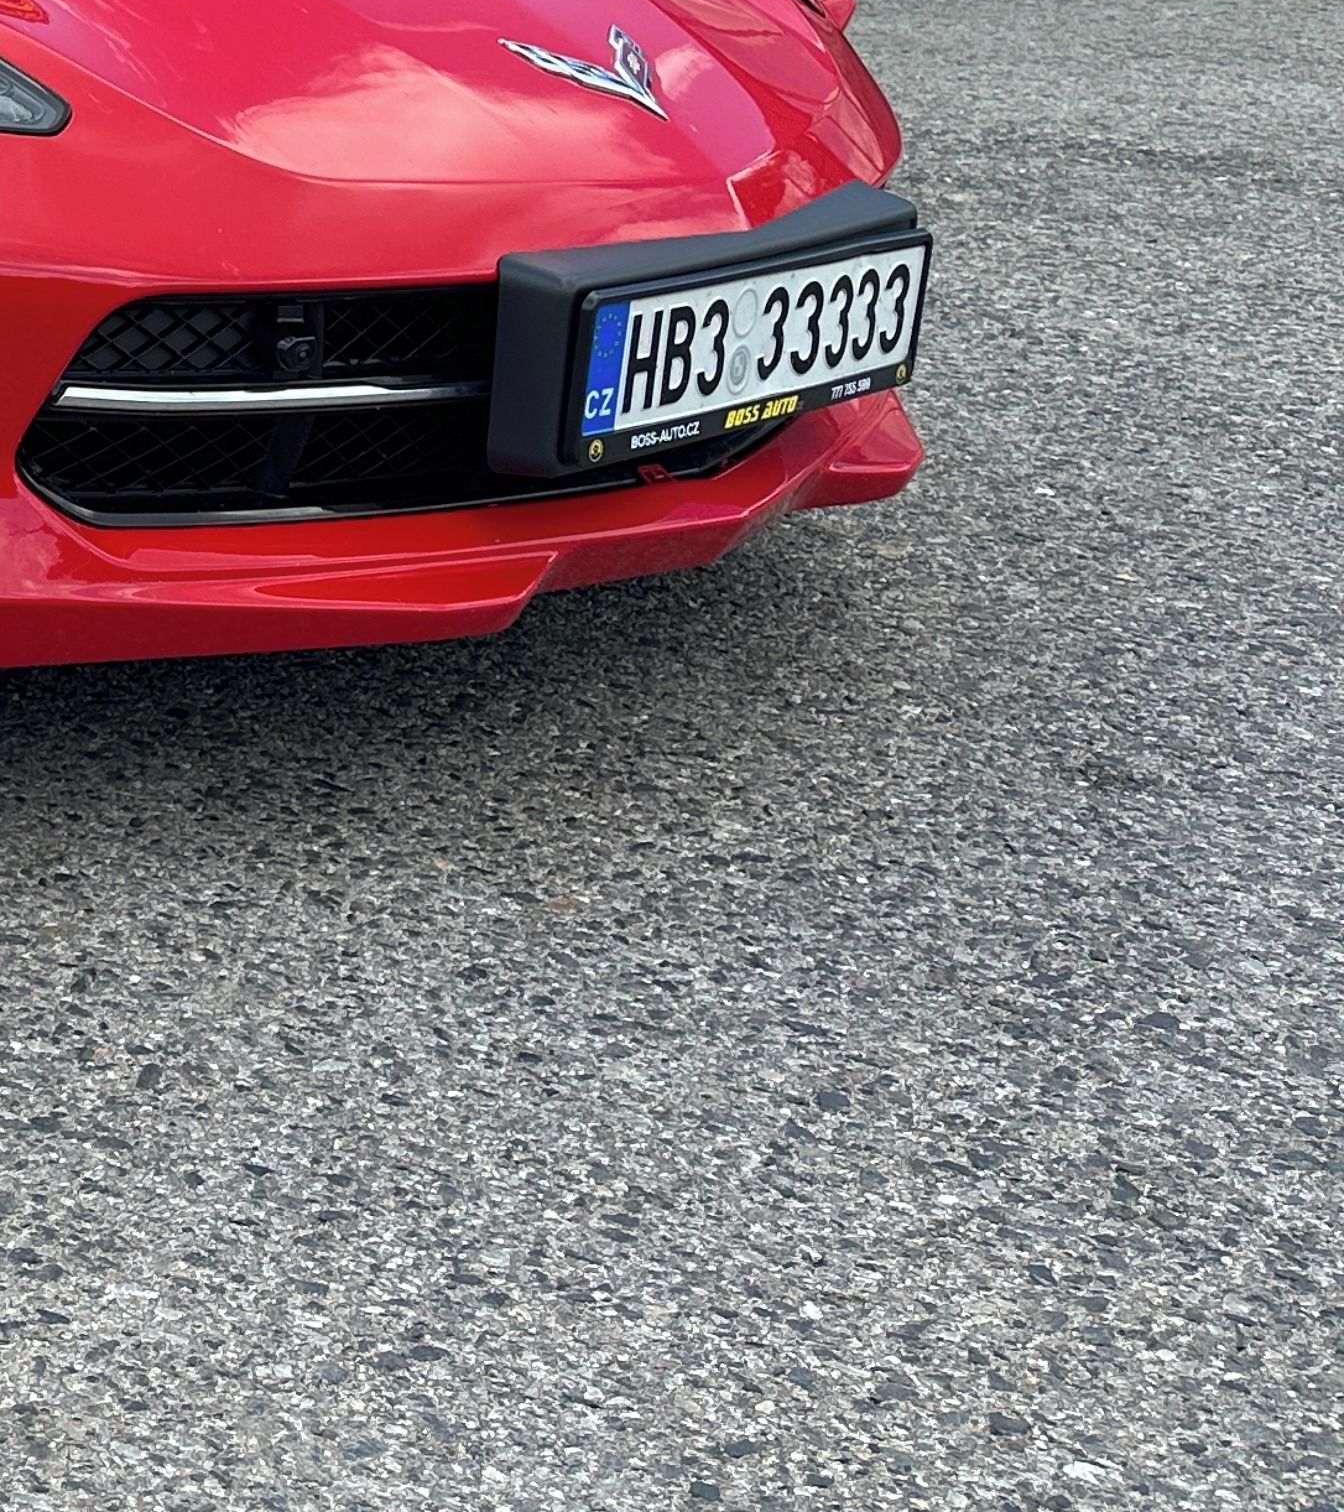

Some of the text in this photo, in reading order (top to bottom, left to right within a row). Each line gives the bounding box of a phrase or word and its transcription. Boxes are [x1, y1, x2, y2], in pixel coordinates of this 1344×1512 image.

[620, 263, 910, 414] HB3 33333
[584, 387, 614, 420] CZ
[630, 420, 701, 449] BOSS-AUTO.CZ
[724, 404, 761, 429] BOSS
[762, 395, 799, 421] AUTO
